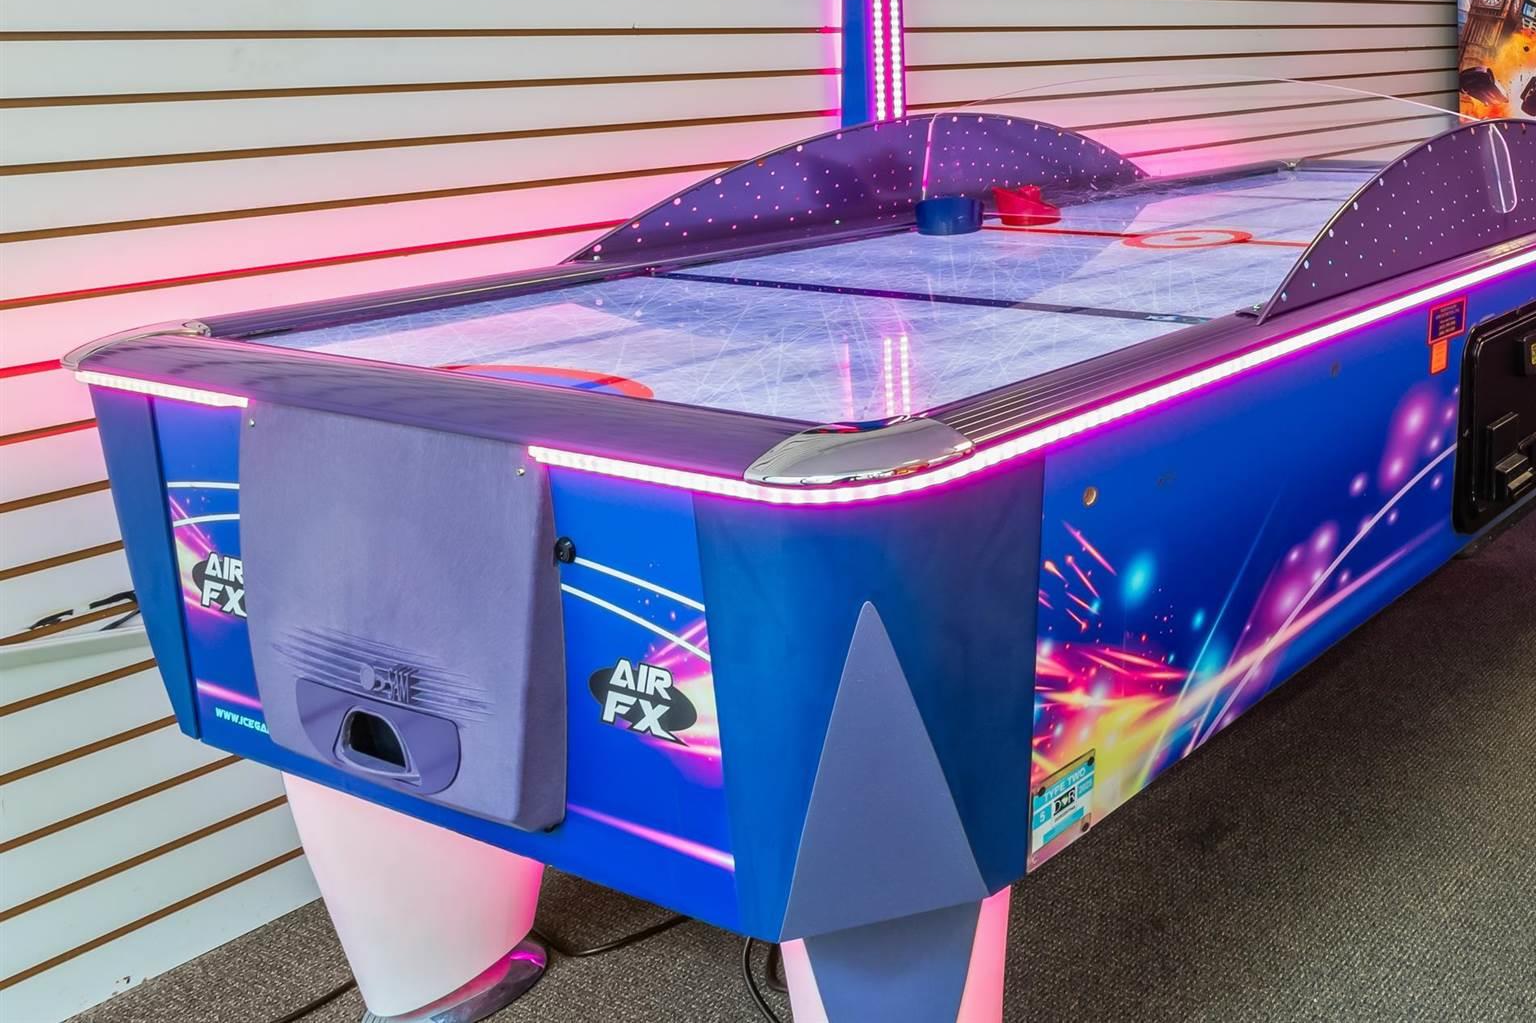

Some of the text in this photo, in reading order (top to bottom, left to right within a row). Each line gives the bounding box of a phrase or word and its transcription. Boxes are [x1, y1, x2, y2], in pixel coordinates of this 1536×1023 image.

[204, 551, 244, 583] AIR
[201, 587, 247, 618] FX
[608, 657, 672, 698] AIR
[215, 707, 269, 734] WWW.ICEGA
[601, 694, 690, 746] FX
[1043, 783, 1066, 802] TYPE
[1068, 767, 1087, 787] TWO
